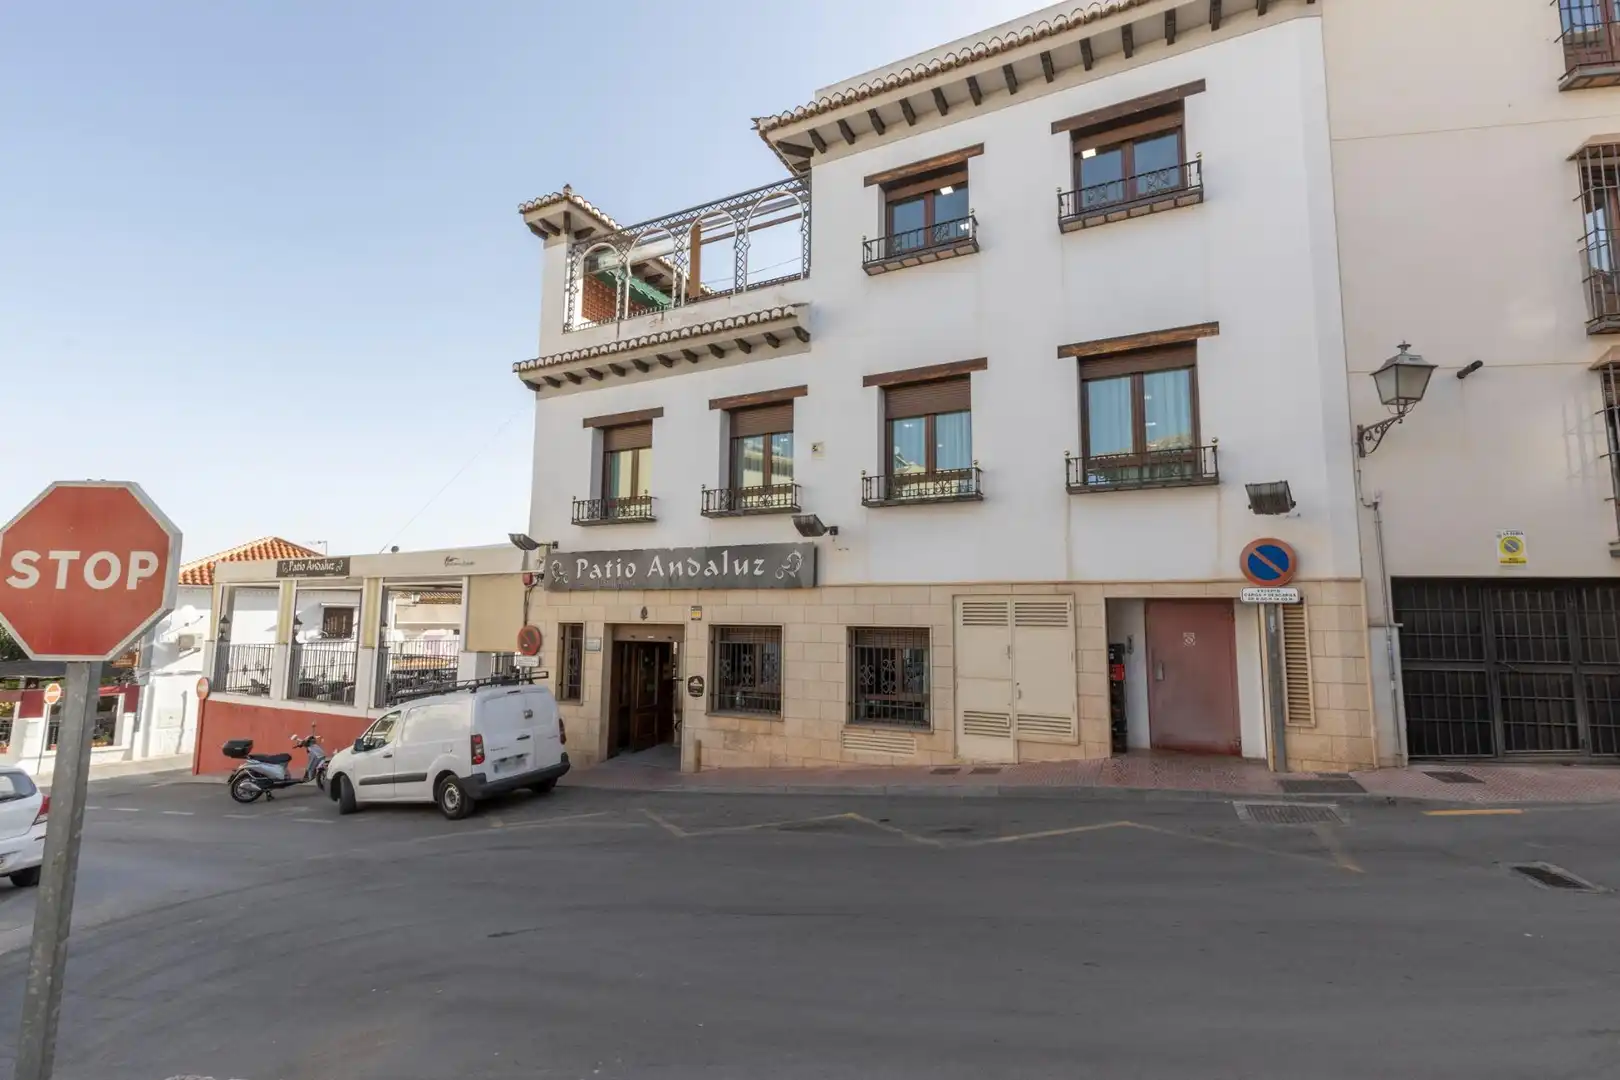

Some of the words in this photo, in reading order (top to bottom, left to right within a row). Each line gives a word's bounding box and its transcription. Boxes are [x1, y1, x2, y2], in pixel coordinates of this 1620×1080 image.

[5, 550, 159, 590] STOP
[289, 560, 305, 572] Patio
[306, 559, 335, 571] Andaluz
[576, 558, 637, 580] Patio
[647, 550, 765, 577] Andaluz
